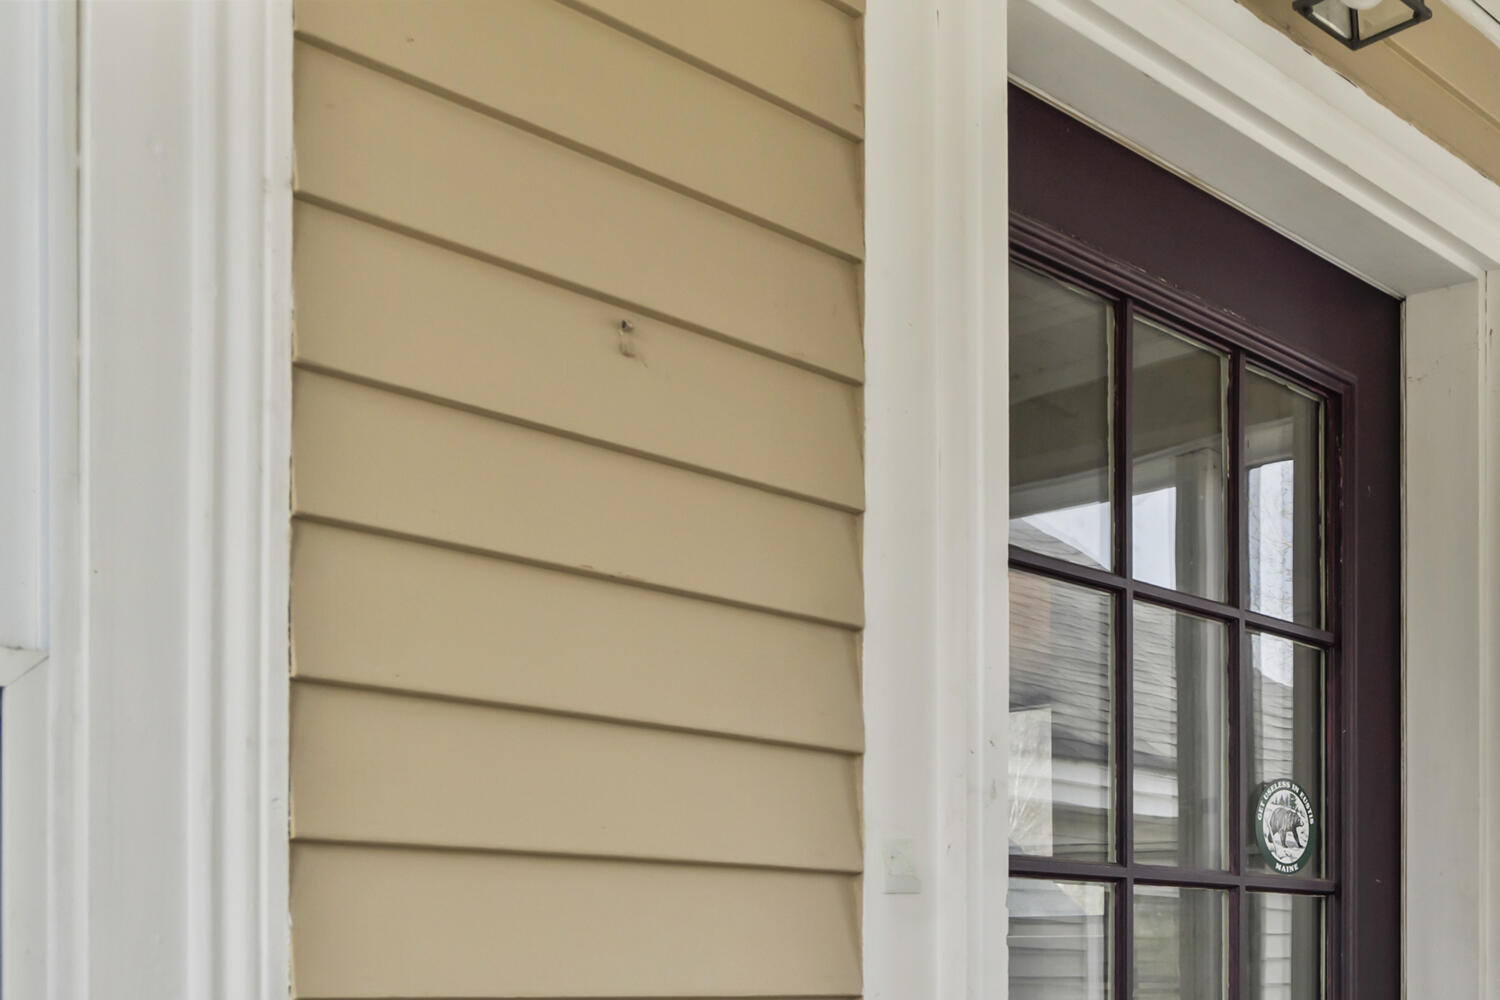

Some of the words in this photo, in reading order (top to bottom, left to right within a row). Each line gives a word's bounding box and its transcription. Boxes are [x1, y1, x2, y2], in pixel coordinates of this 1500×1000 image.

[1257, 800, 1265, 821] GET
[1263, 781, 1291, 800] USELESS
[1291, 783, 1300, 794] IN
[1299, 791, 1315, 825] EUSTIS
[1275, 863, 1299, 873] MAINE
